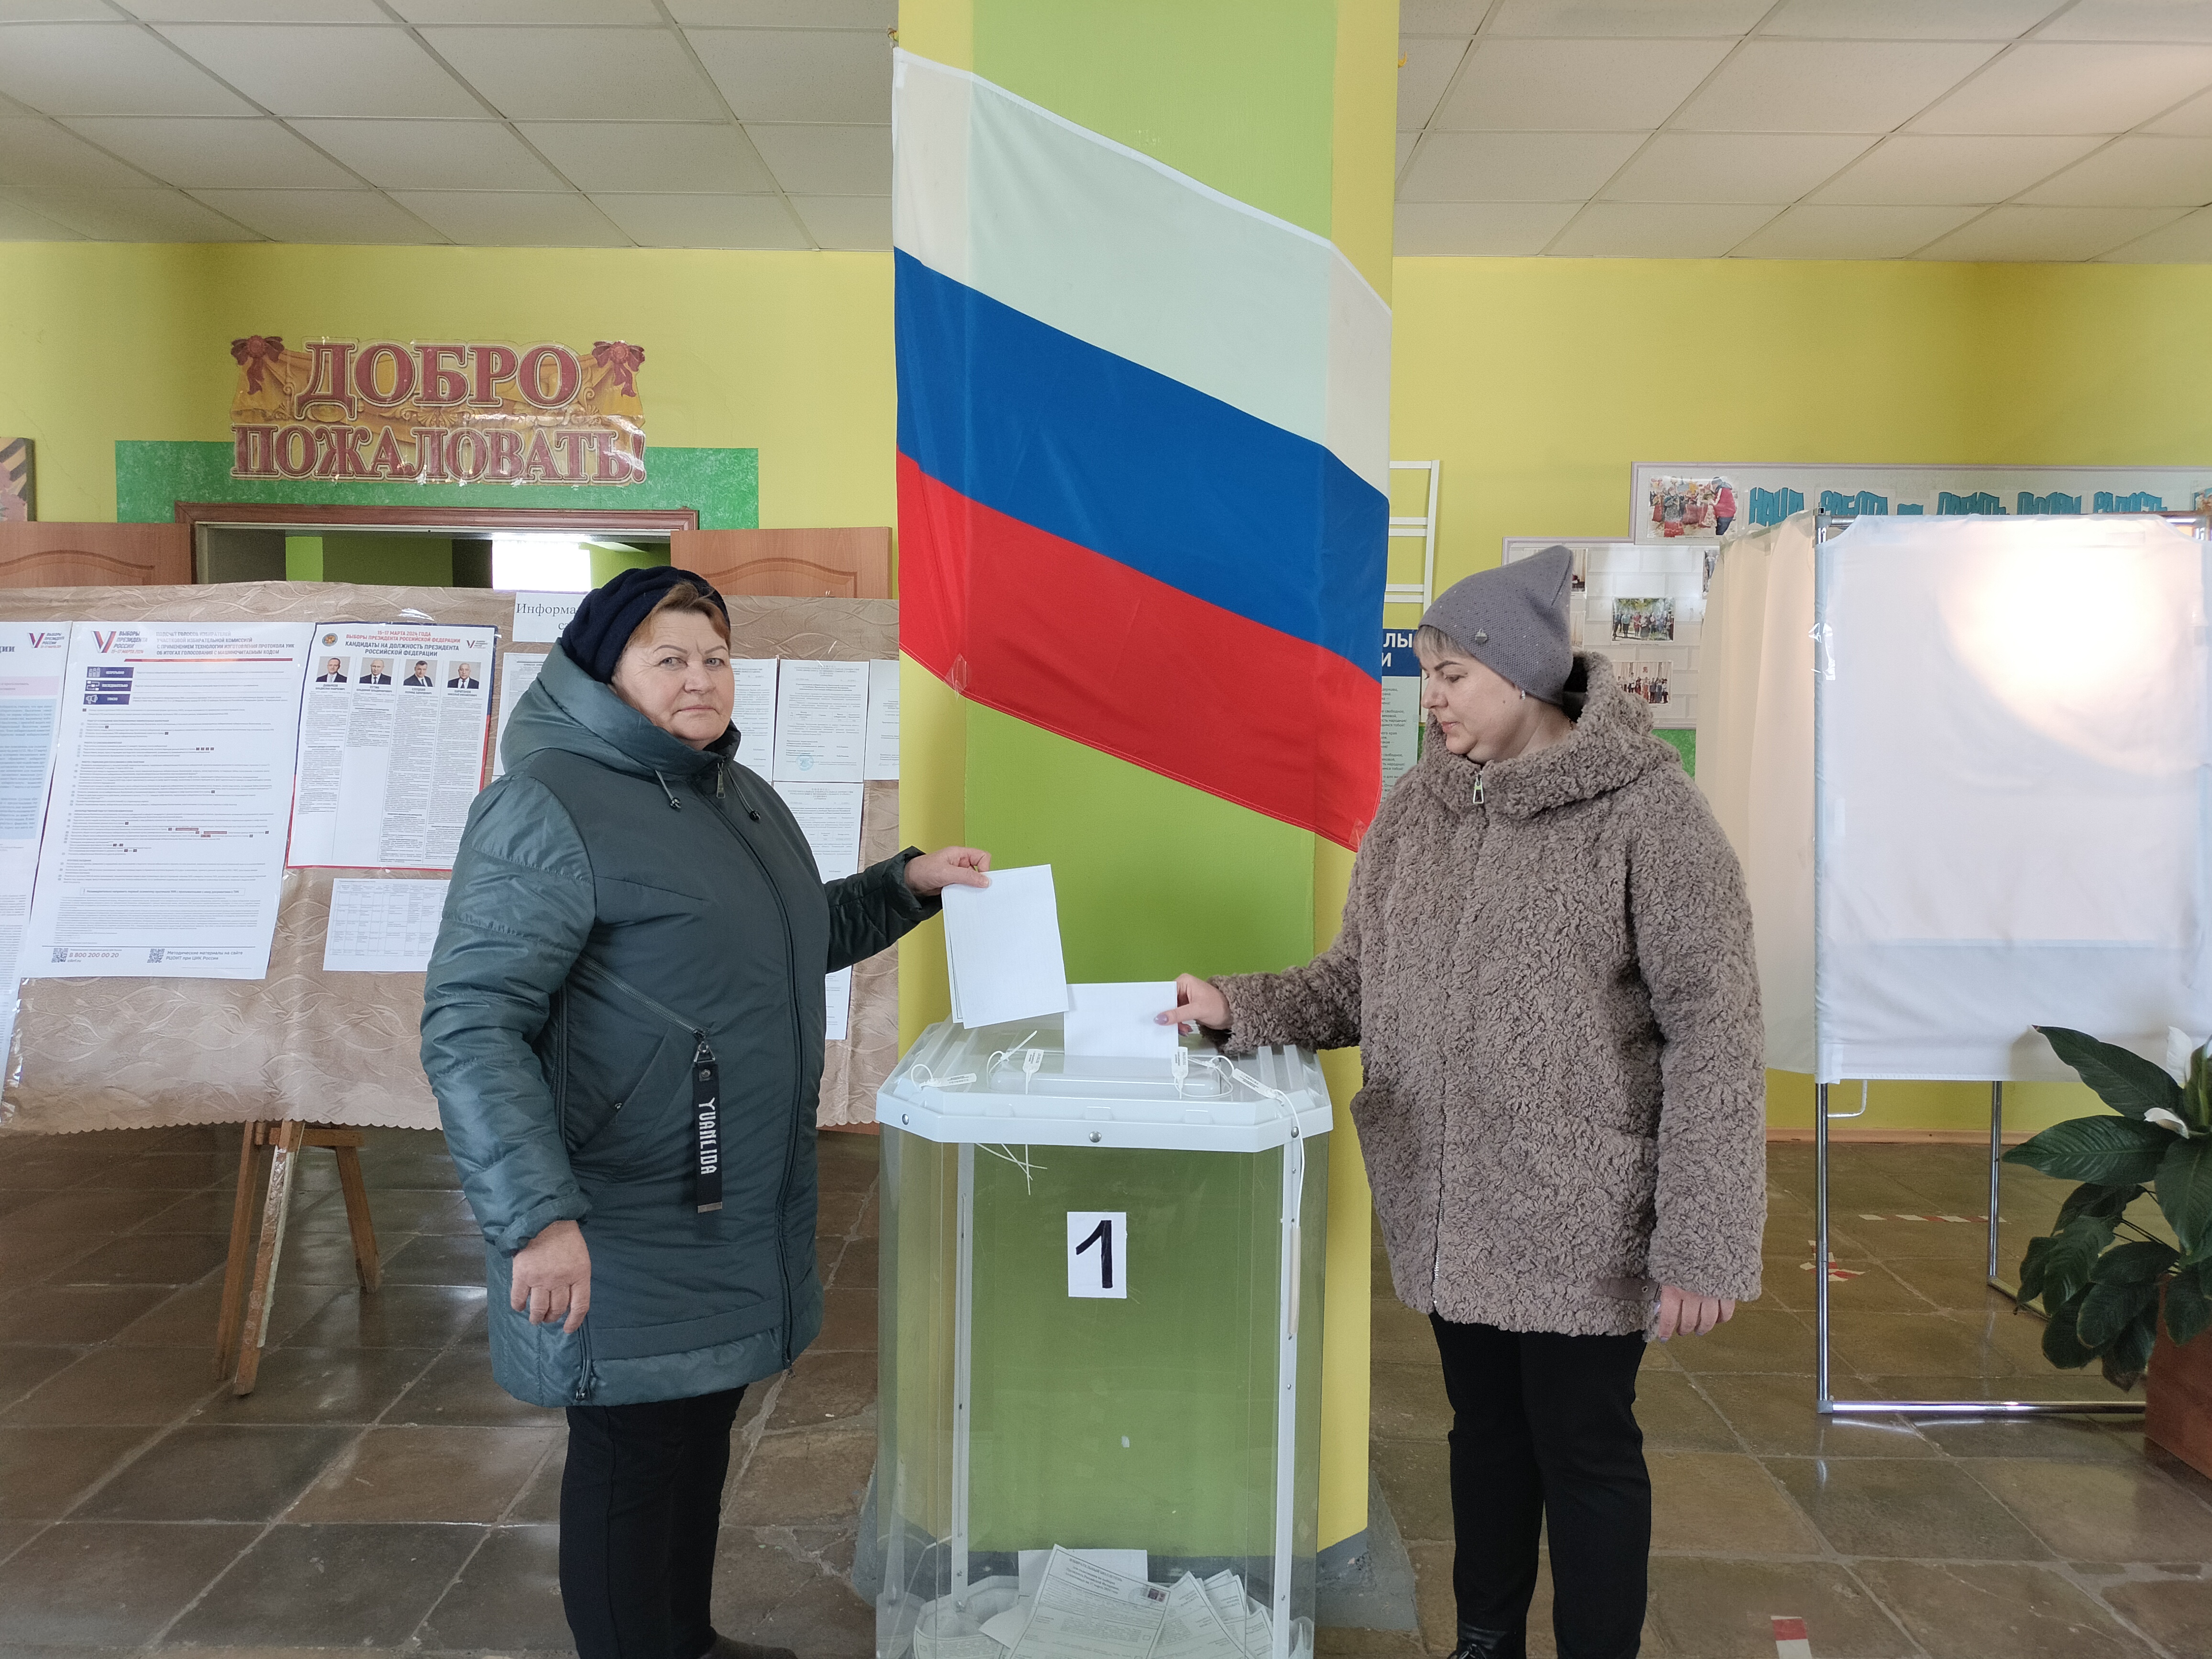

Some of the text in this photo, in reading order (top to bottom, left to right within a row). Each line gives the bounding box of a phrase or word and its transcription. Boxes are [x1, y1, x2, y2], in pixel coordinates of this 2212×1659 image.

[294, 342, 580, 420] ДОБРО
[232, 424, 646, 483] ПОЖАЛОВАТЬ!
[1748, 487, 1804, 527] НАША
[516, 603, 578, 617] Информа
[698, 1097, 718, 1175] YUANLIDA
[1075, 1219, 1113, 1289] 1
